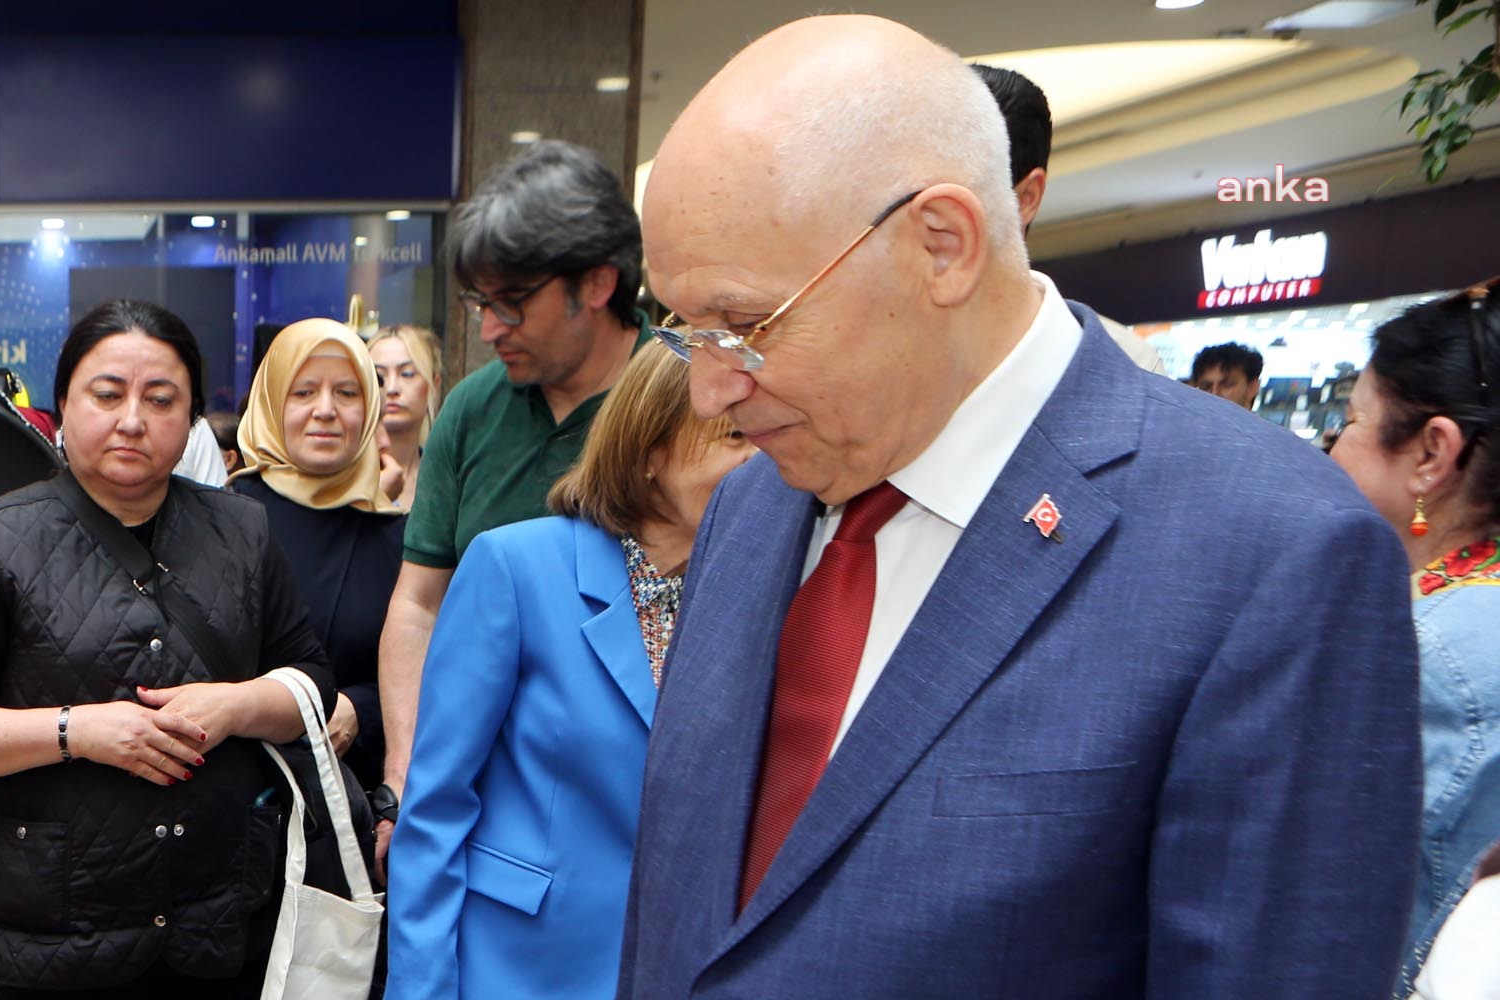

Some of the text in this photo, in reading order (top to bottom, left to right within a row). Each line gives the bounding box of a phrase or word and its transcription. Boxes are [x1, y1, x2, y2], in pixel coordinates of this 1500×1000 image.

[213, 242, 298, 263] Ankamall
[302, 243, 346, 263] AVM
[1204, 278, 1312, 309] COMPUTER
